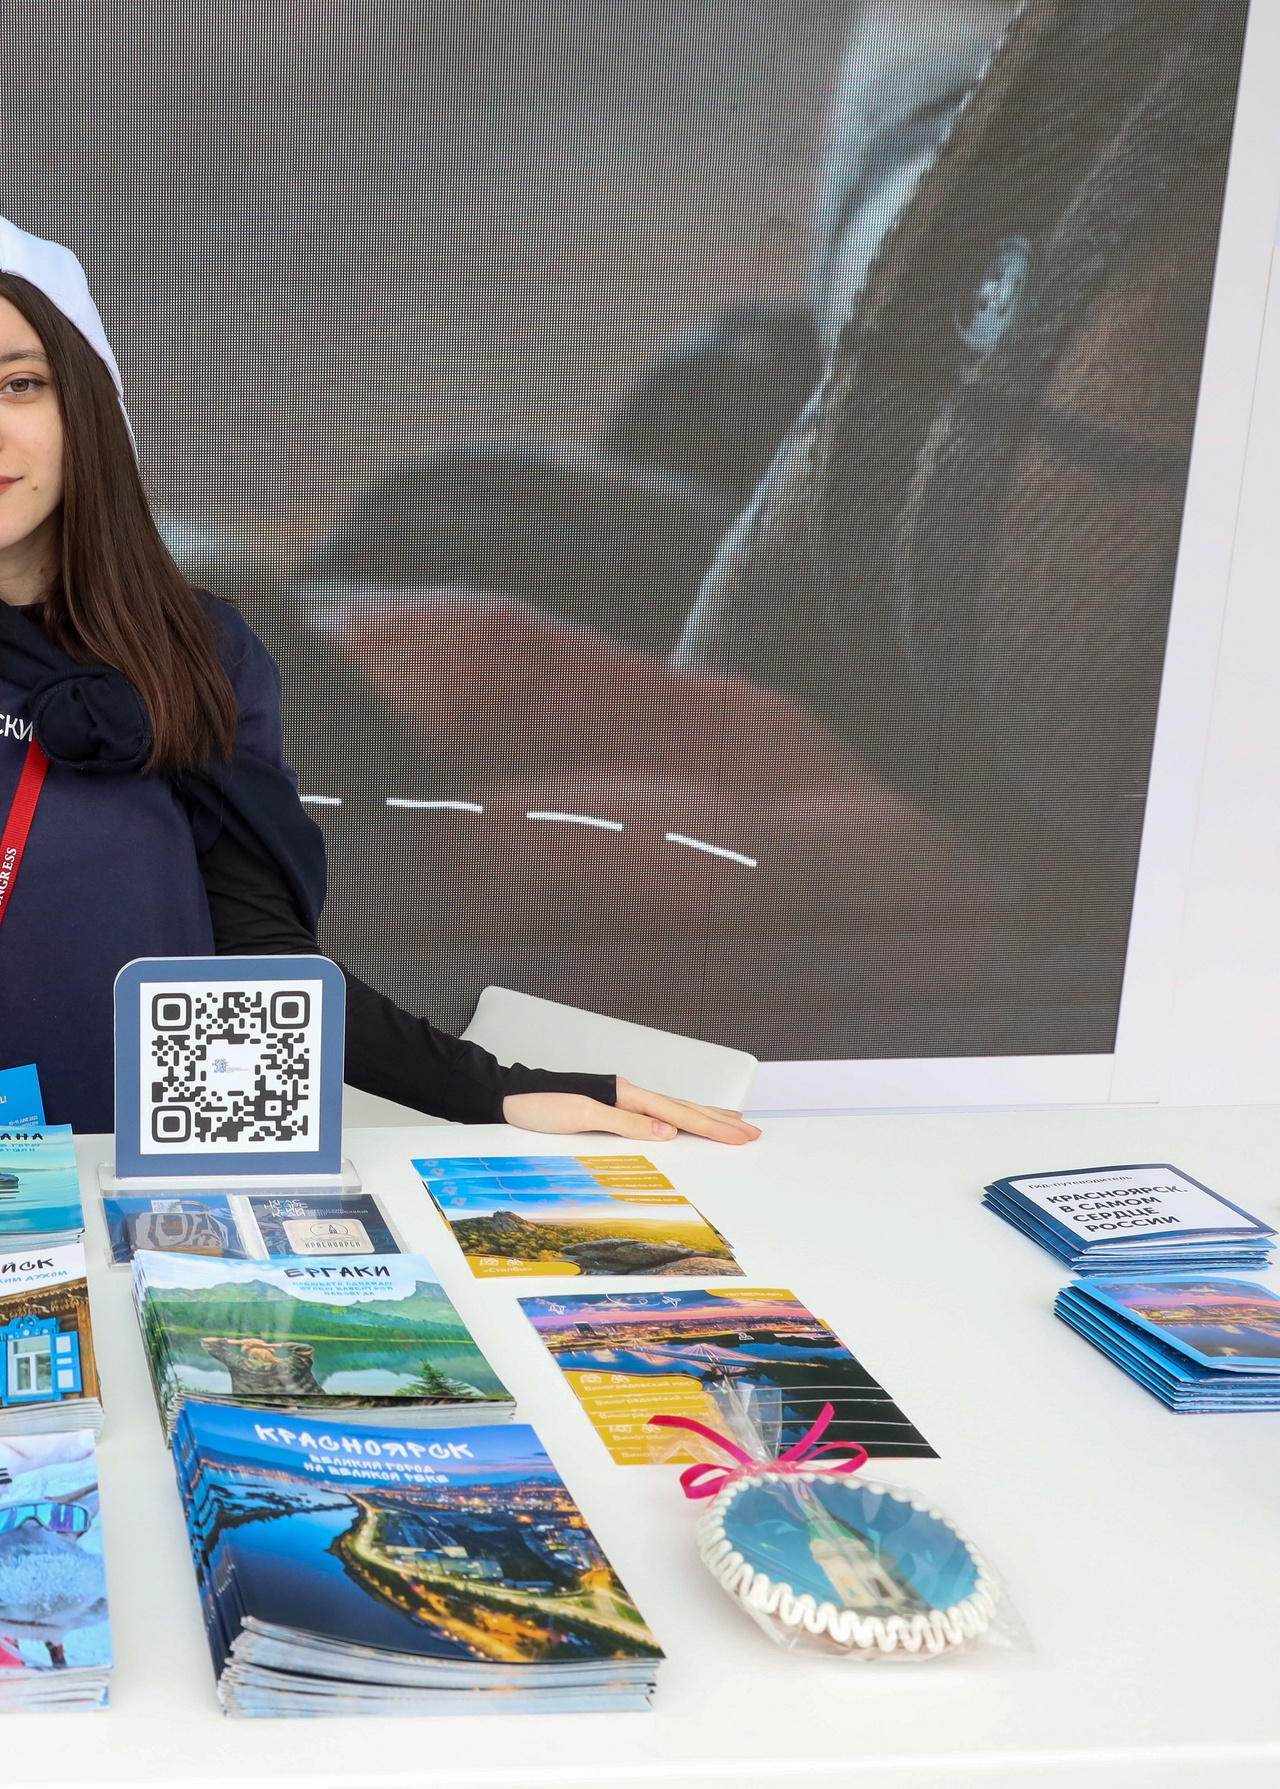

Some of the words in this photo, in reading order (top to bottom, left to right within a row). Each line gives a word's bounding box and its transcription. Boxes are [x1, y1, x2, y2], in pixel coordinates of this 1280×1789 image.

[1046, 1185, 1188, 1204] КРАСНОЯРСК.
[1058, 1205, 1076, 1213] В
[1078, 1196, 1162, 1211] САМОМ
[1072, 1207, 1160, 1223] СЕРДЦЕ
[1085, 1216, 1181, 1233] РОССИИ
[283, 1265, 391, 1278] ЕРГАКИ
[584, 1381, 670, 1392] Виноградовский
[594, 1394, 682, 1406] Виноградовский
[254, 1424, 475, 1459] КРАСНОЯРСК
[304, 1461, 325, 1474] НА
[384, 1461, 436, 1475] ГОРОД
